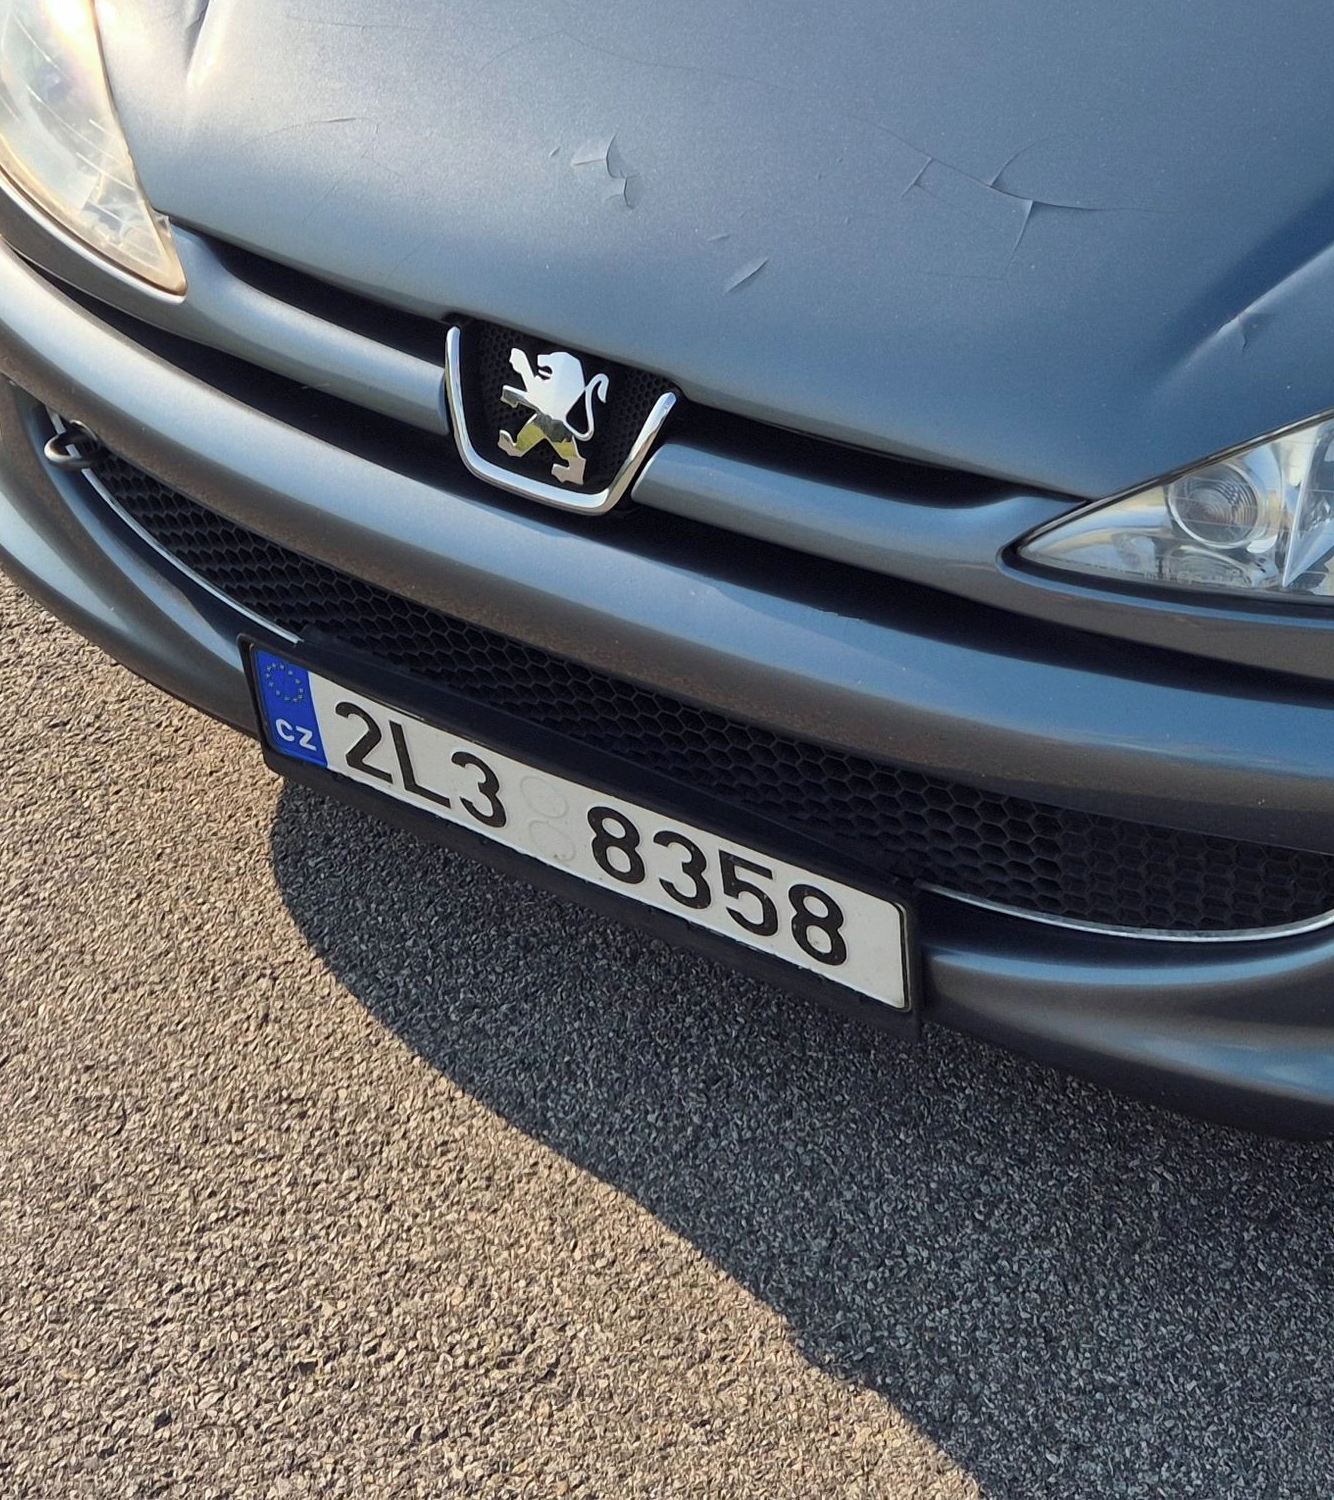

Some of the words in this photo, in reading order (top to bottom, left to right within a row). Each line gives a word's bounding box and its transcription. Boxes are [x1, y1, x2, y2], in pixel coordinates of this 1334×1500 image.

[275, 718, 317, 752] CZ
[335, 701, 507, 828] 2L3
[587, 806, 847, 966] 8358
